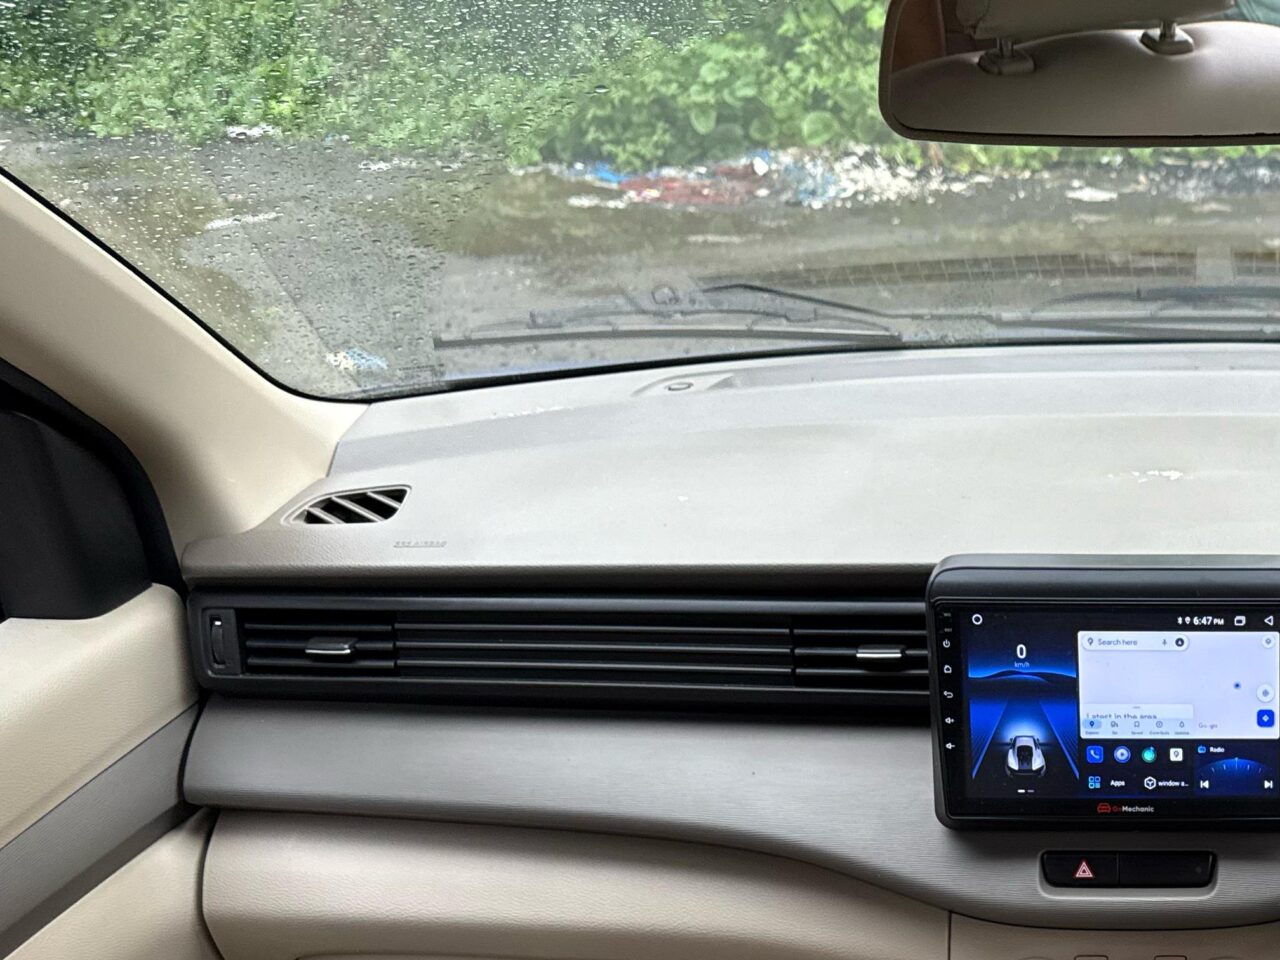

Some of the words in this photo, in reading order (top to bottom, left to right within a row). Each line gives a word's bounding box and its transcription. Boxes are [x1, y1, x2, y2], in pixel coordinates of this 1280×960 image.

[1193, 616, 1213, 626] 6:47
[1213, 618, 1225, 626] PM
[1097, 638, 1122, 647] Search
[1122, 638, 1138, 647] here
[1016, 644, 1027, 660] 0
[1014, 661, 1031, 669] km/h
[1110, 779, 1126, 788] Apps
[1158, 779, 1180, 787] window
